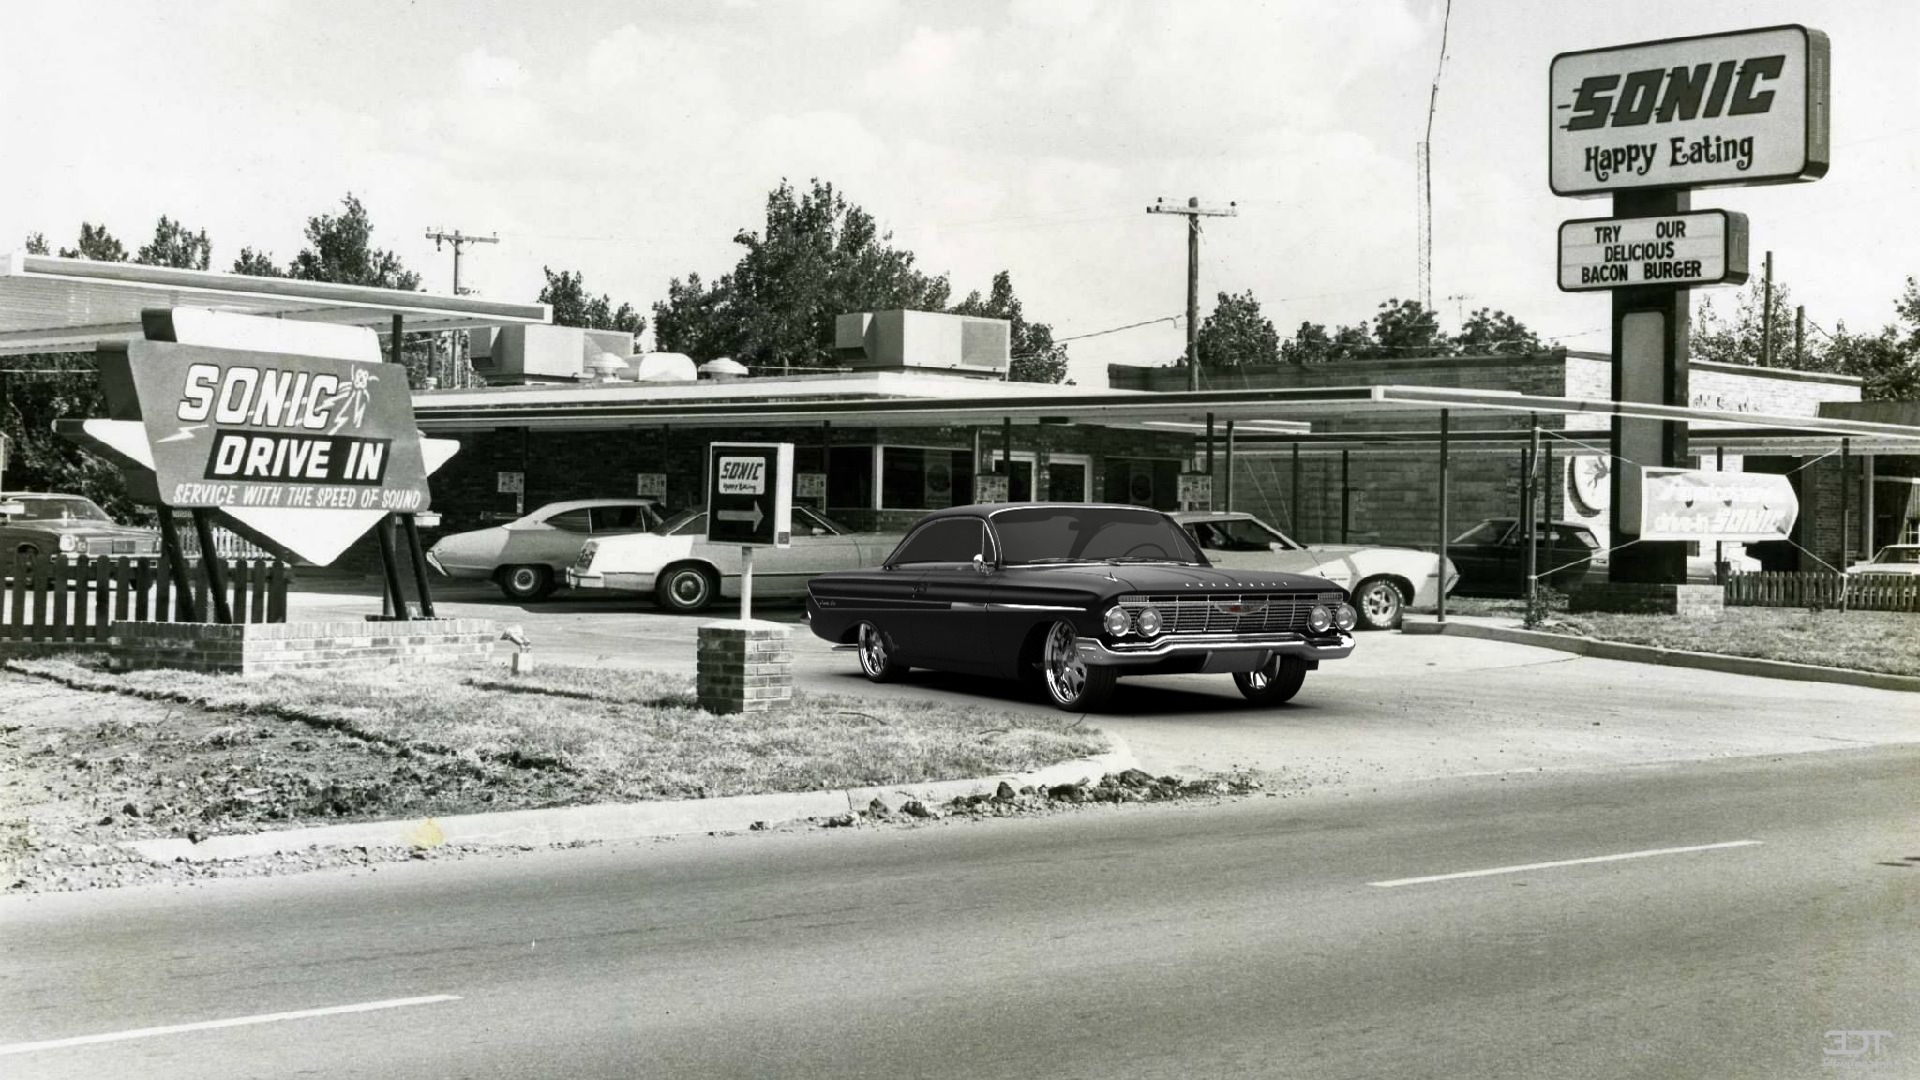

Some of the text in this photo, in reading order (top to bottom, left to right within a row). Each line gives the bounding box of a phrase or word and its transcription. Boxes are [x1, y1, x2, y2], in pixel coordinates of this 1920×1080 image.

[1562, 54, 1786, 131] SONIC
[1584, 135, 1754, 182] Happy Eating
[1594, 220, 1686, 244] TRY OUR
[1604, 241, 1675, 262] DELICIOUS
[1581, 260, 1702, 284] BACON BURGER
[177, 363, 339, 430] SONIC
[214, 435, 384, 481] DRIVE IN
[720, 462, 764, 480] SONIC
[173, 483, 422, 509] SERVICE WITH THE SPEED OF SOUND
